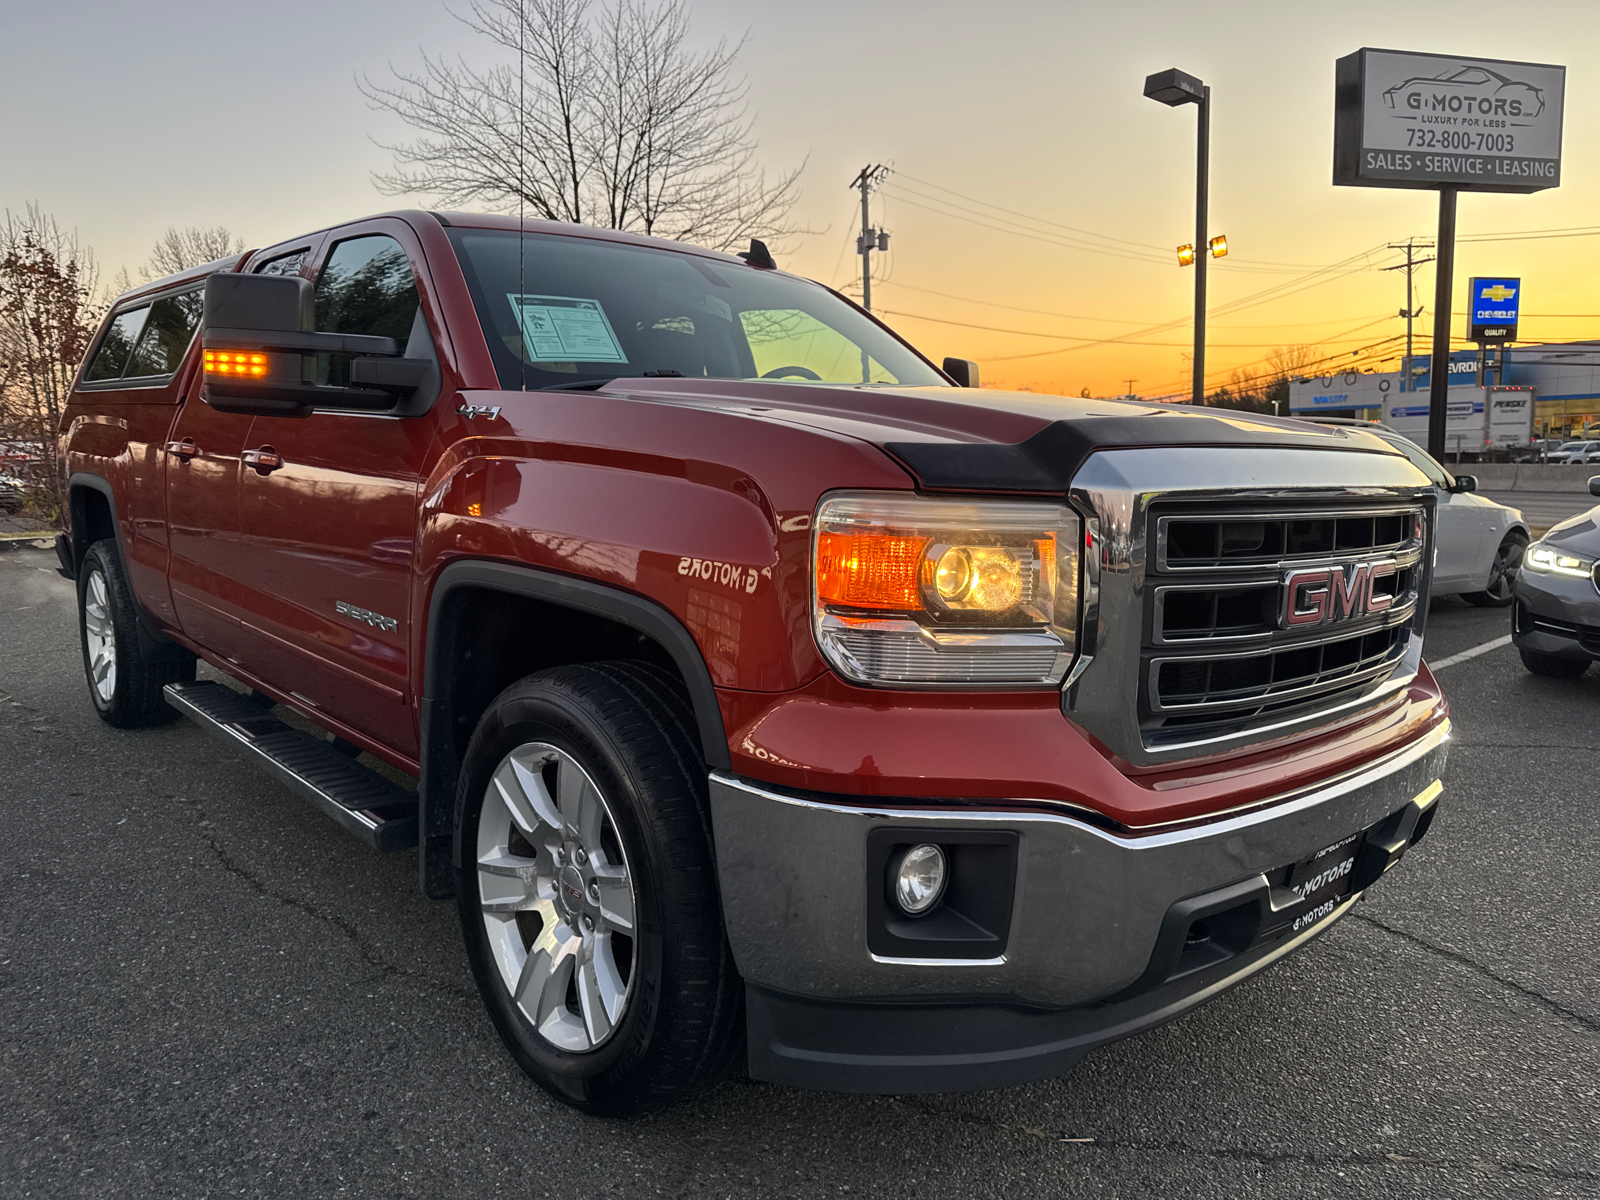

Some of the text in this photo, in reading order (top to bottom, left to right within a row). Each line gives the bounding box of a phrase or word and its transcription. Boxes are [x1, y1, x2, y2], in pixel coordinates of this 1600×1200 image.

[1421, 114, 1506, 129] LUXURY FOR LESS
[1406, 128, 1514, 152] 732-800-7003
[1366, 152, 1555, 178] SALES SERVICE LEASING
[1477, 310, 1516, 319] CHEVROLET
[1281, 558, 1397, 630] GMC
[335, 600, 398, 635] SIERRA
